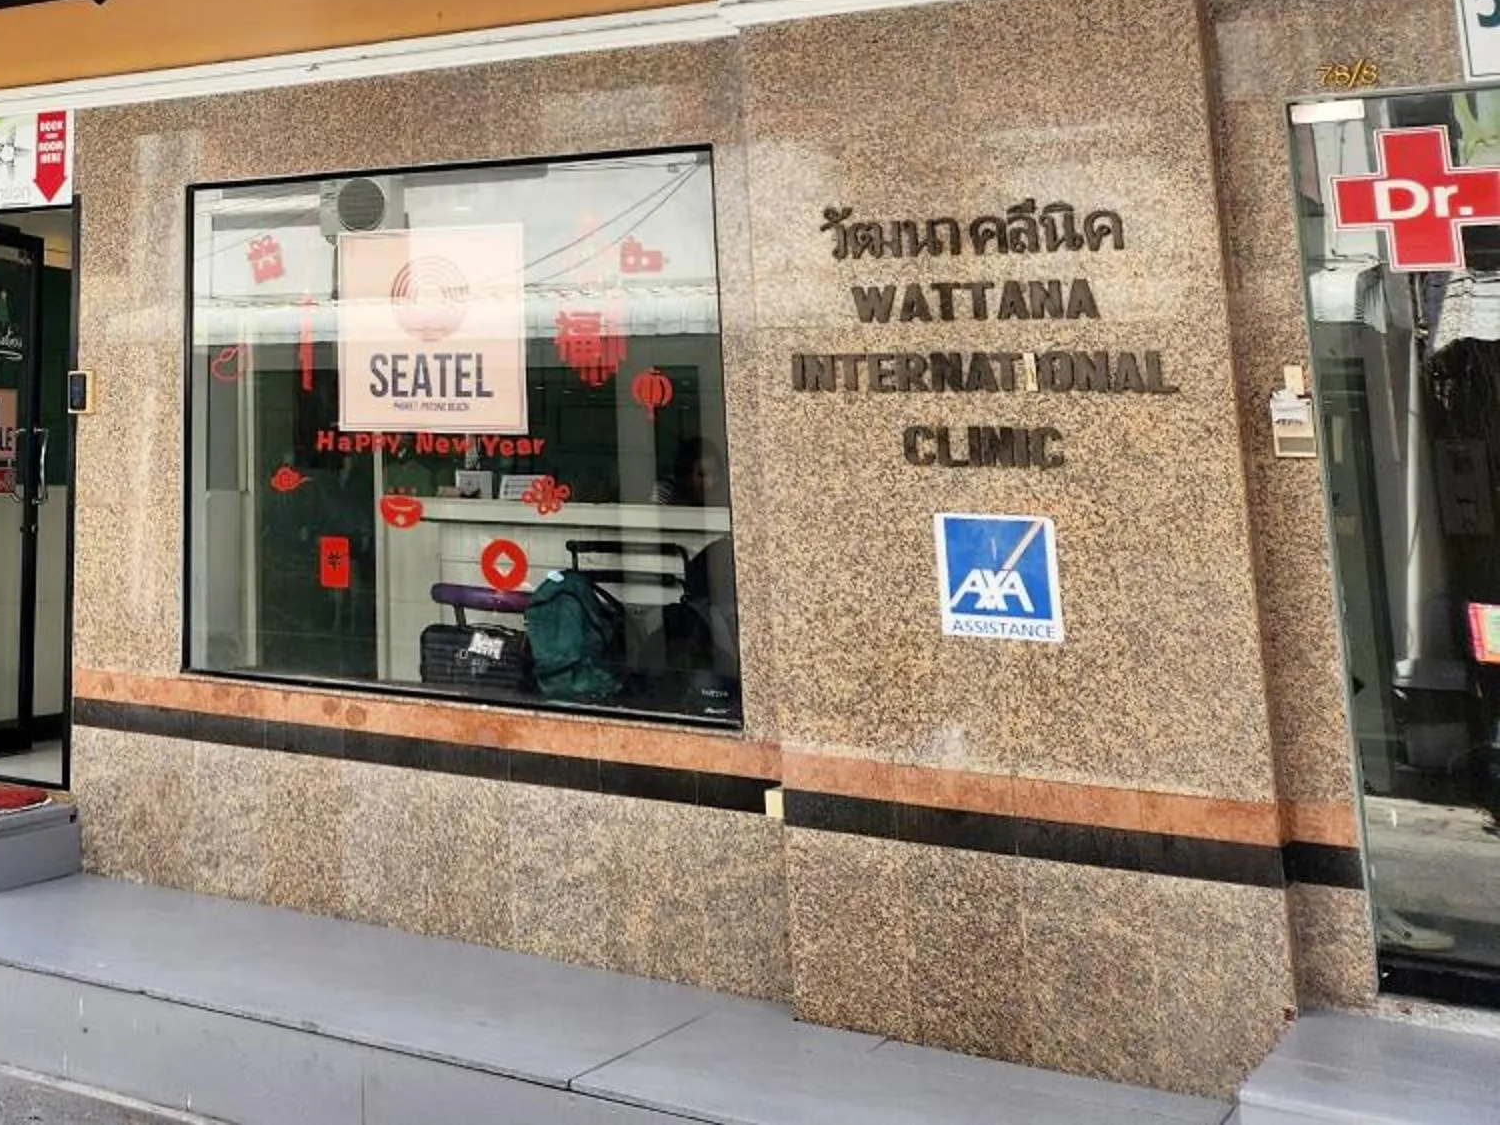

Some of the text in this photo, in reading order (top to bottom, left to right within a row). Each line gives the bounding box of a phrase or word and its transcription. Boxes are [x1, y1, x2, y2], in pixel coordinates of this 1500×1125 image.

[1373, 179, 1474, 221] Dr.
[851, 278, 1100, 324] WATTANA
[369, 352, 495, 398] SEATEL
[791, 350, 1181, 394] INTERNATIONAL
[415, 432, 470, 455] New
[480, 434, 545, 458] Year
[902, 425, 1065, 471] CLINIC
[950, 567, 1035, 613] AXA
[951, 618, 1057, 639] ASSISTANCE
